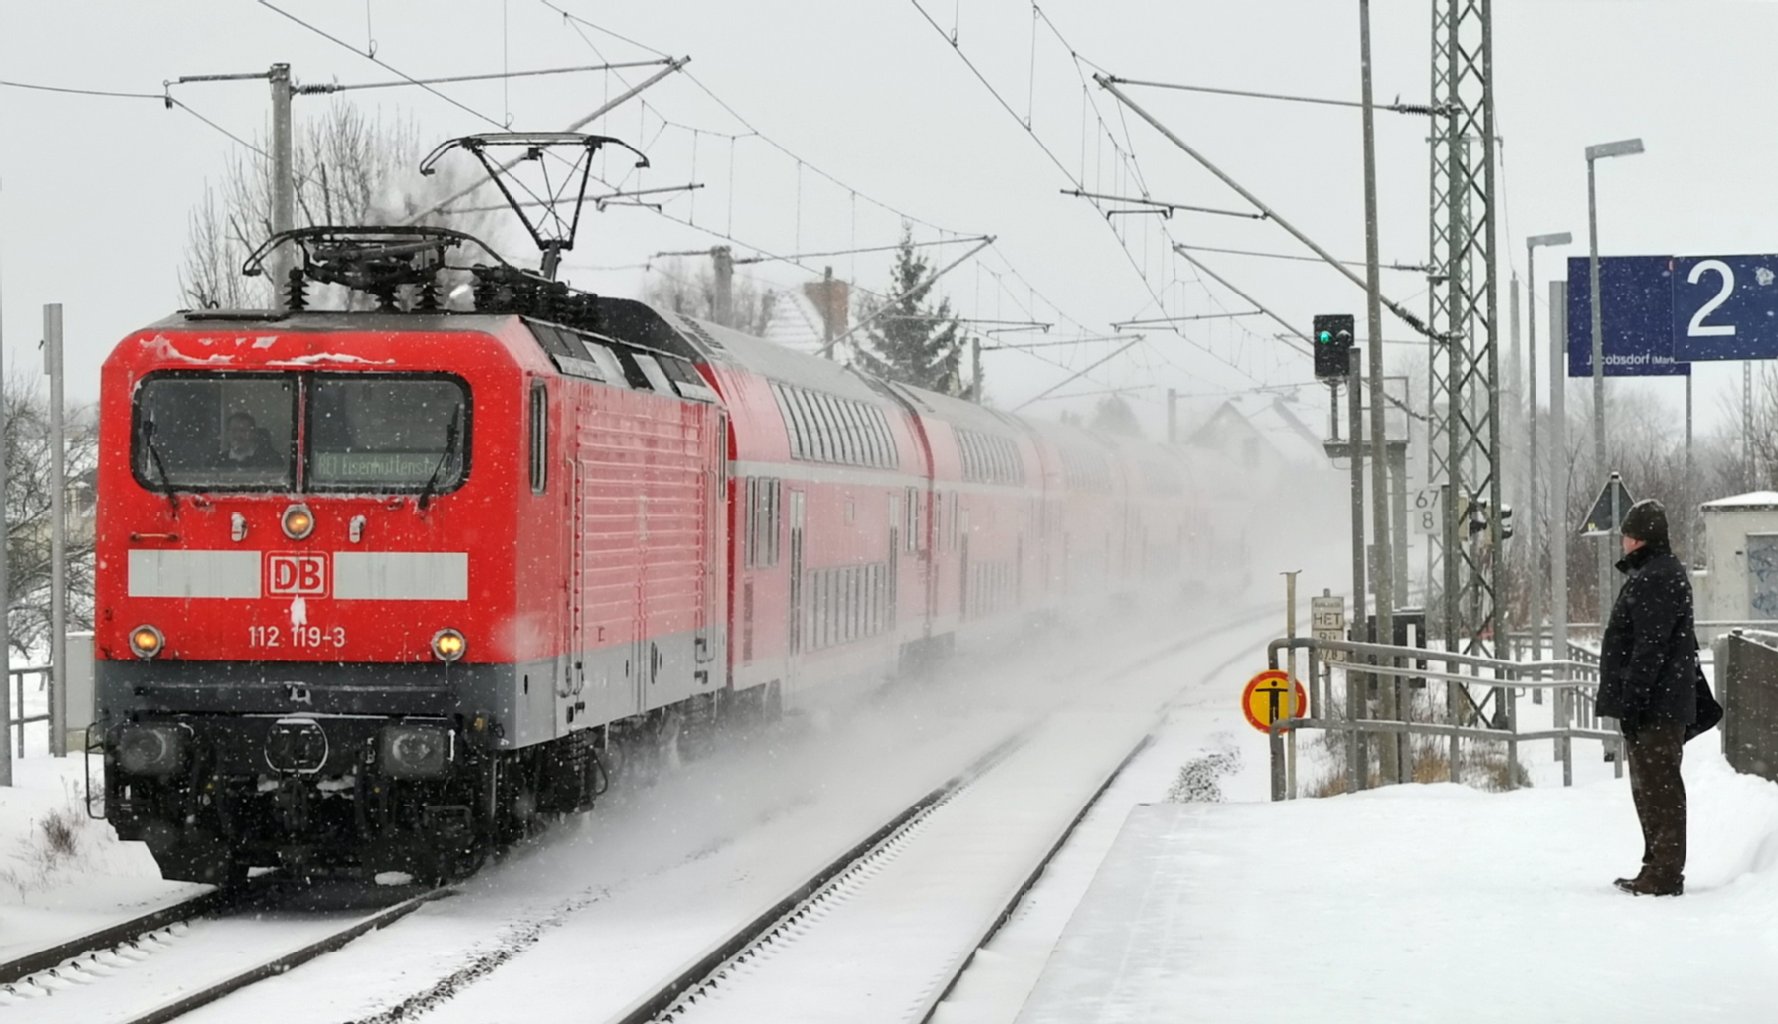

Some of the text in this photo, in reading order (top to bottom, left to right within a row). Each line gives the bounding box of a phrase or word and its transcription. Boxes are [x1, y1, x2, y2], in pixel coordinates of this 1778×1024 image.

[1687, 259, 1735, 336] 2
[1586, 353, 1650, 365] Jobsdorf
[1415, 490, 1439, 509] 67
[1422, 511, 1434, 529] 8
[275, 559, 321, 590] DB
[1313, 612, 1343, 625] HET
[248, 626, 345, 648] 112 119-3
